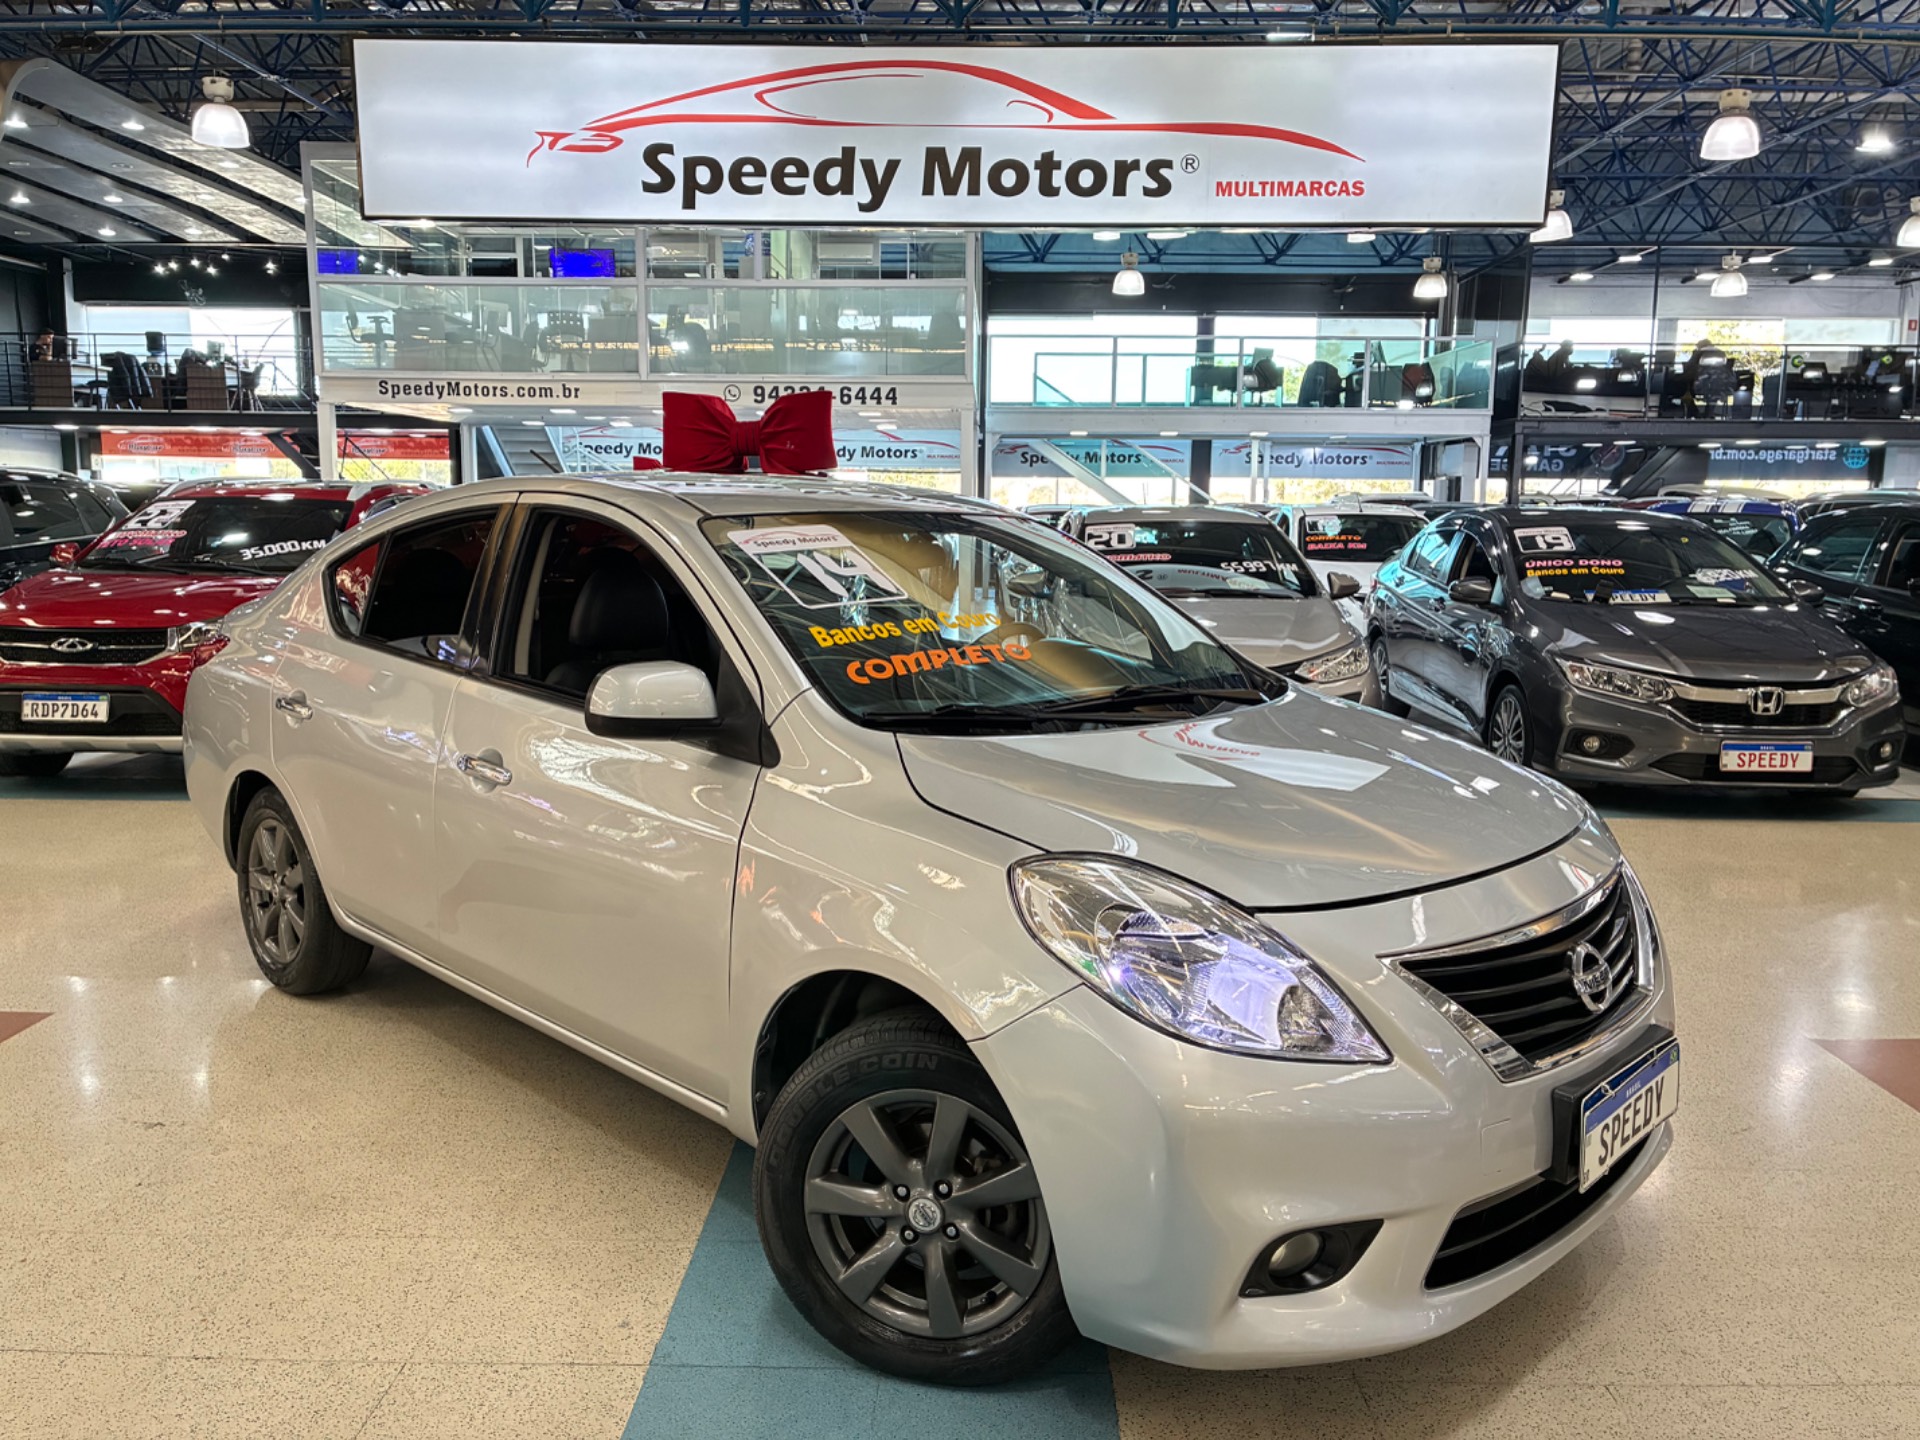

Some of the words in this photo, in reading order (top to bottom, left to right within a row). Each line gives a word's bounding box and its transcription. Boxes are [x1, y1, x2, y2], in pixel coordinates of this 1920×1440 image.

[641, 143, 901, 212] Speedy
[921, 146, 1175, 198] Motors
[1215, 179, 1366, 197] MULTIMARCAS
[377, 379, 580, 399] SpeedyMotors.com.br
[860, 445, 918, 459] Motors
[128, 508, 181, 528] 22
[753, 538, 798, 549] Speedy
[797, 535, 839, 545] Motors
[1087, 531, 1134, 548] 20
[1305, 534, 1362, 542] COMPLETO
[1307, 542, 1345, 551] BAIXA
[1347, 542, 1367, 550] KM
[1534, 534, 1573, 550] 19
[1525, 558, 1574, 568] ÚNICO
[1578, 558, 1623, 567] DONO
[796, 549, 898, 599] 14
[1526, 569, 1569, 578] Bancos
[1571, 568, 1589, 576] em
[1591, 566, 1625, 576] Couro
[808, 620, 903, 648] Bancos
[903, 616, 940, 634] em
[936, 611, 1002, 630] Couro
[846, 643, 1033, 685] COMPLETO
[30, 702, 99, 719] RDP7D64
[1736, 752, 1800, 769] SPEEDY
[858, 1052, 939, 1074] COIN
[1598, 1076, 1665, 1167] SPEEDY
